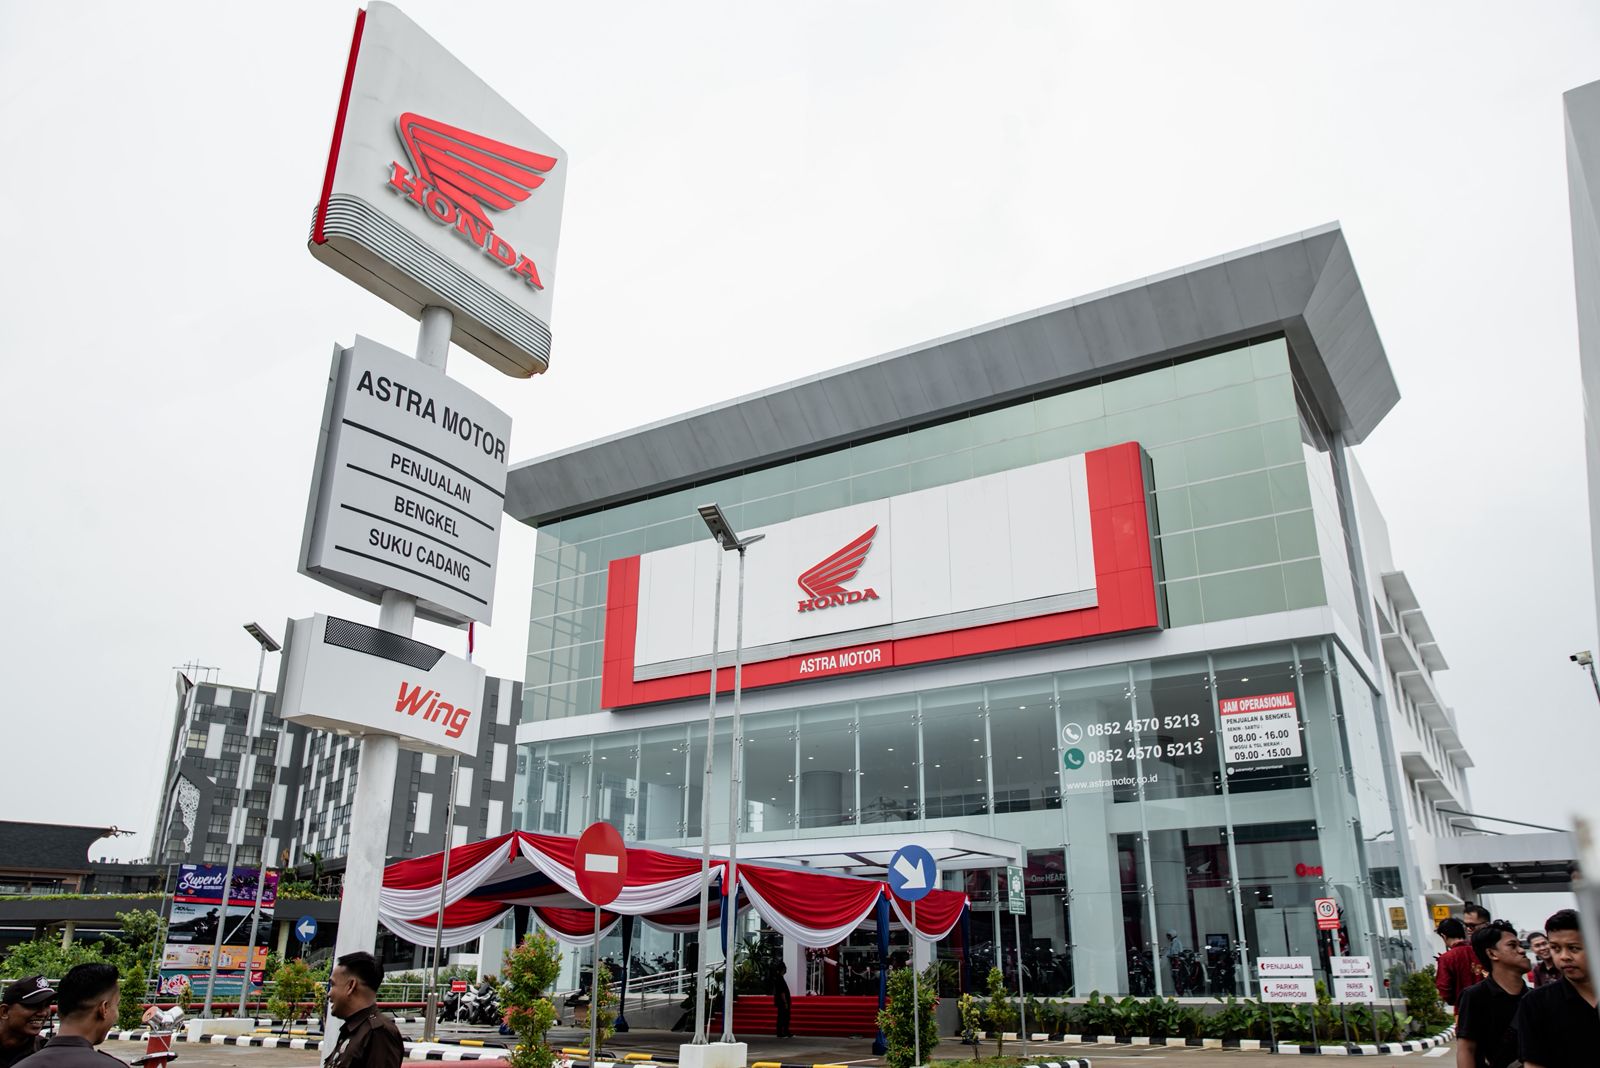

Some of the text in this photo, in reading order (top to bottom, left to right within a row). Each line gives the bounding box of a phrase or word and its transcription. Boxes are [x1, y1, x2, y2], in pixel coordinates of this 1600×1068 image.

[386, 160, 544, 291] HONDA
[356, 370, 506, 463] ASTRA MOTOR
[390, 453, 471, 504] PENJUALAN
[394, 496, 459, 538] BENGKEL
[368, 528, 470, 582] SUKU CADANG
[797, 588, 880, 612] HONDA
[800, 648, 881, 674] ASTRA MOTOR
[394, 681, 472, 739] Wing
[1223, 695, 1292, 713] JAM OPERASIONAL
[1087, 713, 1200, 737] 0852 4570 5213
[1226, 716, 1258, 724] PENJUALAN
[1232, 732, 1257, 743] 08.00
[1264, 729, 1289, 740] 16.00
[1088, 741, 1203, 764] 0852 4570 5213
[1234, 750, 1259, 760] 09.00
[1267, 747, 1292, 757] 15.00
[1066, 773, 1158, 790] www.astramotor.co.id
[1321, 904, 1332, 913] 10
